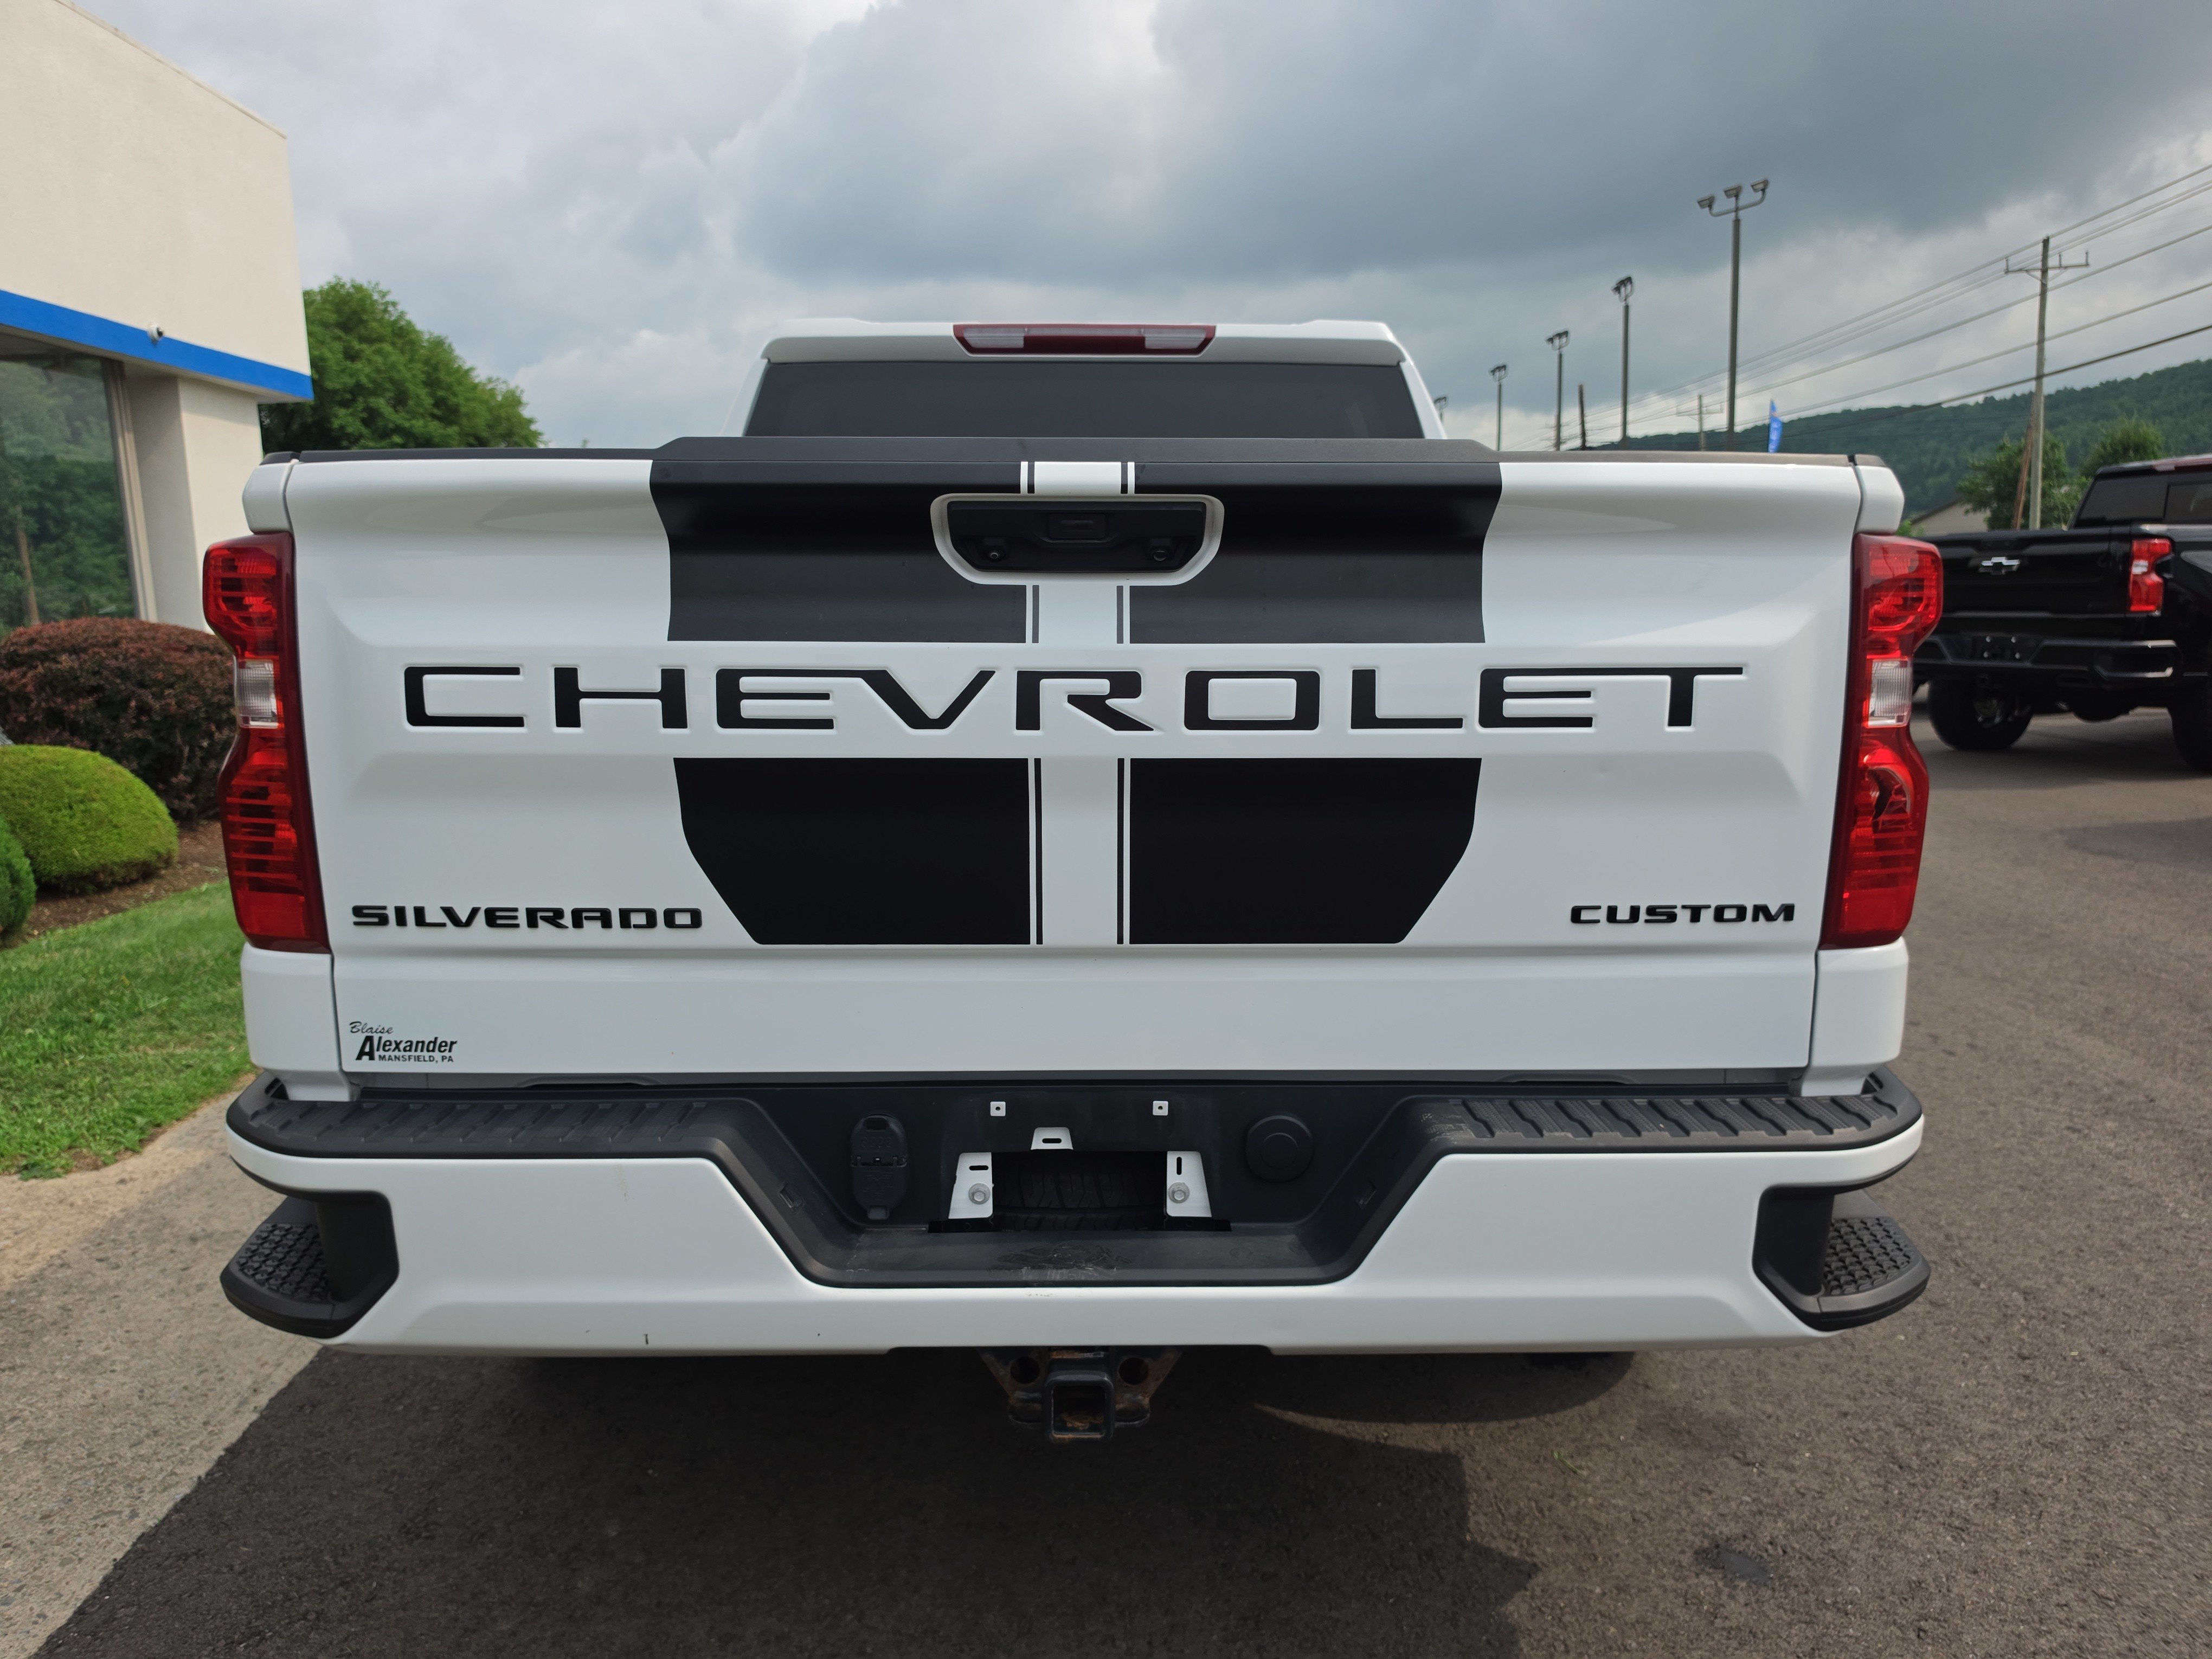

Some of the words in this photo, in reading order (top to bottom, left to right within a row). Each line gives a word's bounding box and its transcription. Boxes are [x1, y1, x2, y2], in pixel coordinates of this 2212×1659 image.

[404, 666, 1742, 731] CHEVROLET
[352, 905, 703, 929] SILVERADO
[1571, 904, 1795, 924] CUSTOM
[349, 1021, 394, 1034] Blaise
[356, 1035, 458, 1061] Alexander
[378, 1054, 438, 1064] MANSFIELD,
